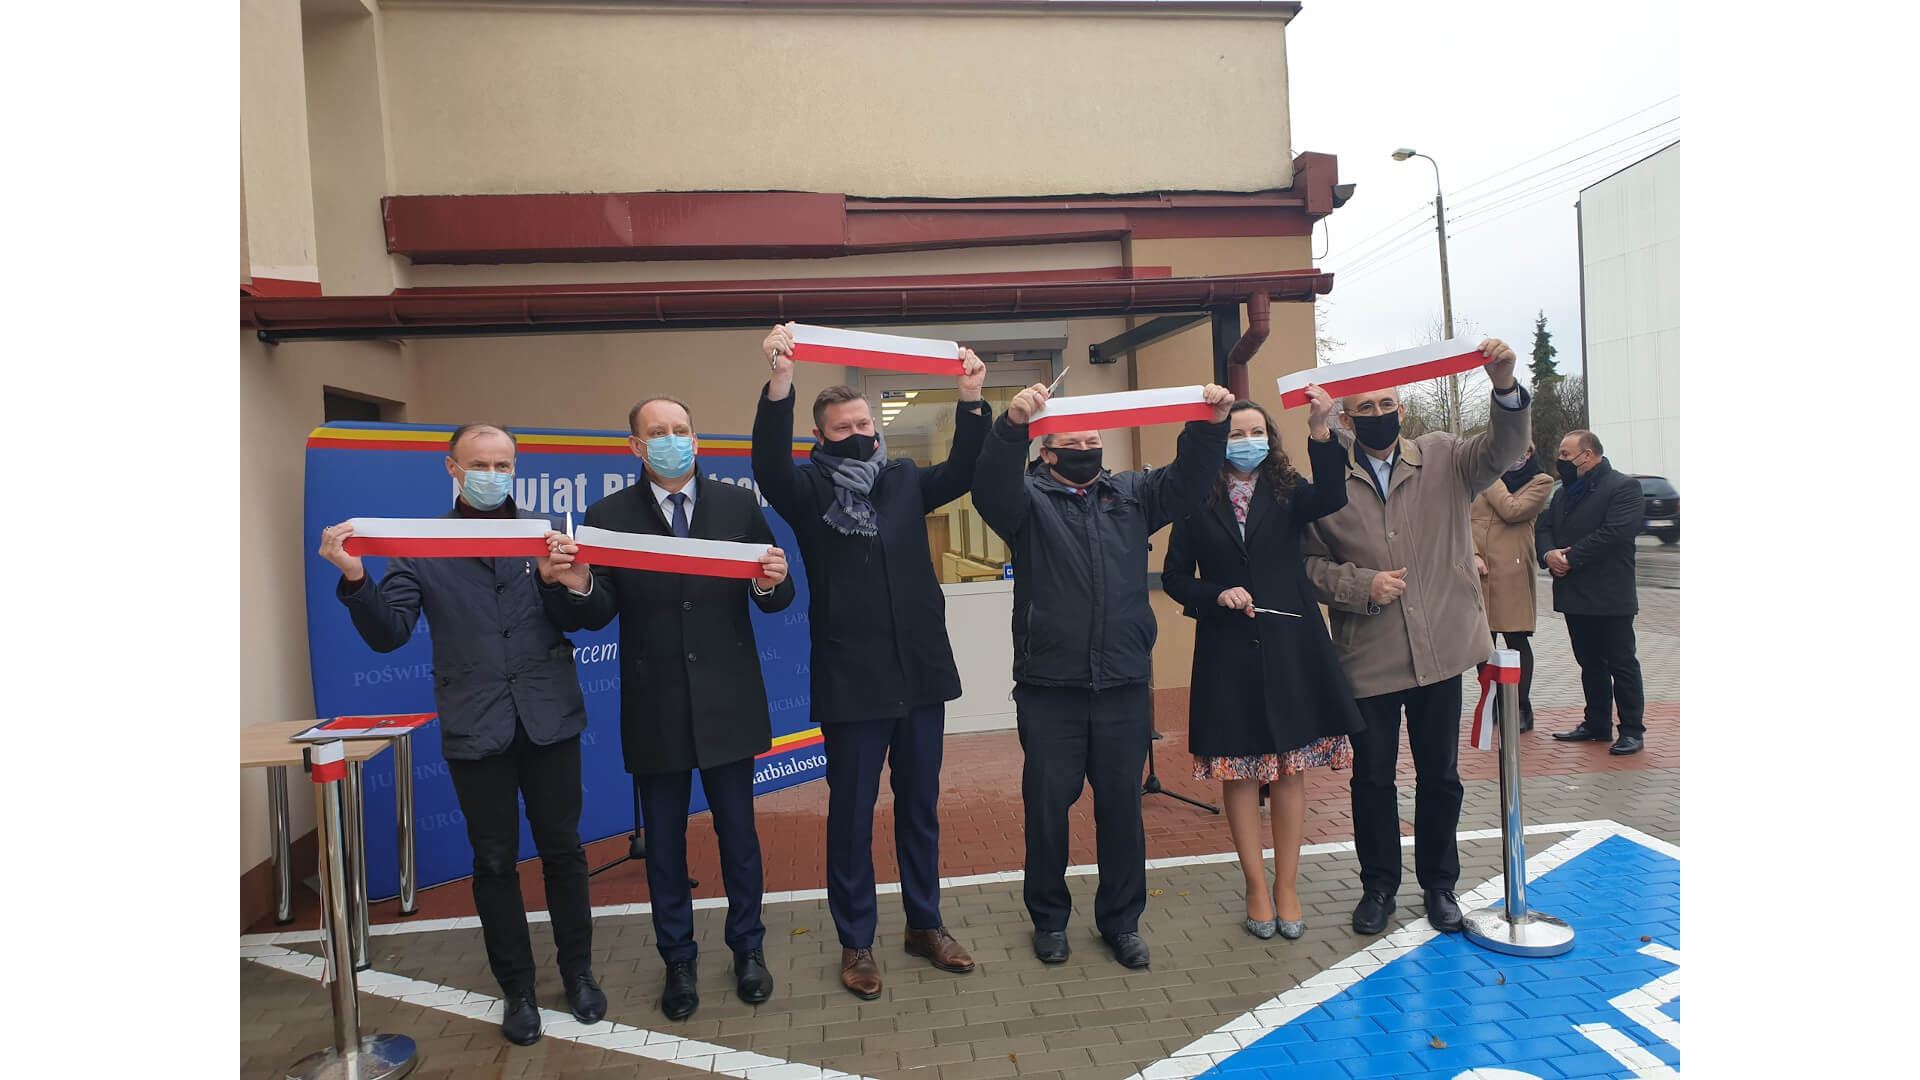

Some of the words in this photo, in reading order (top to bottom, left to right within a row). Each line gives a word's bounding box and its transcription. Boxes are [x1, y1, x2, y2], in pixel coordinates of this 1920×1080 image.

[572, 642, 618, 664] rcem
[353, 664, 432, 687] POŚWIĘ
[752, 754, 827, 784] atbialosto
